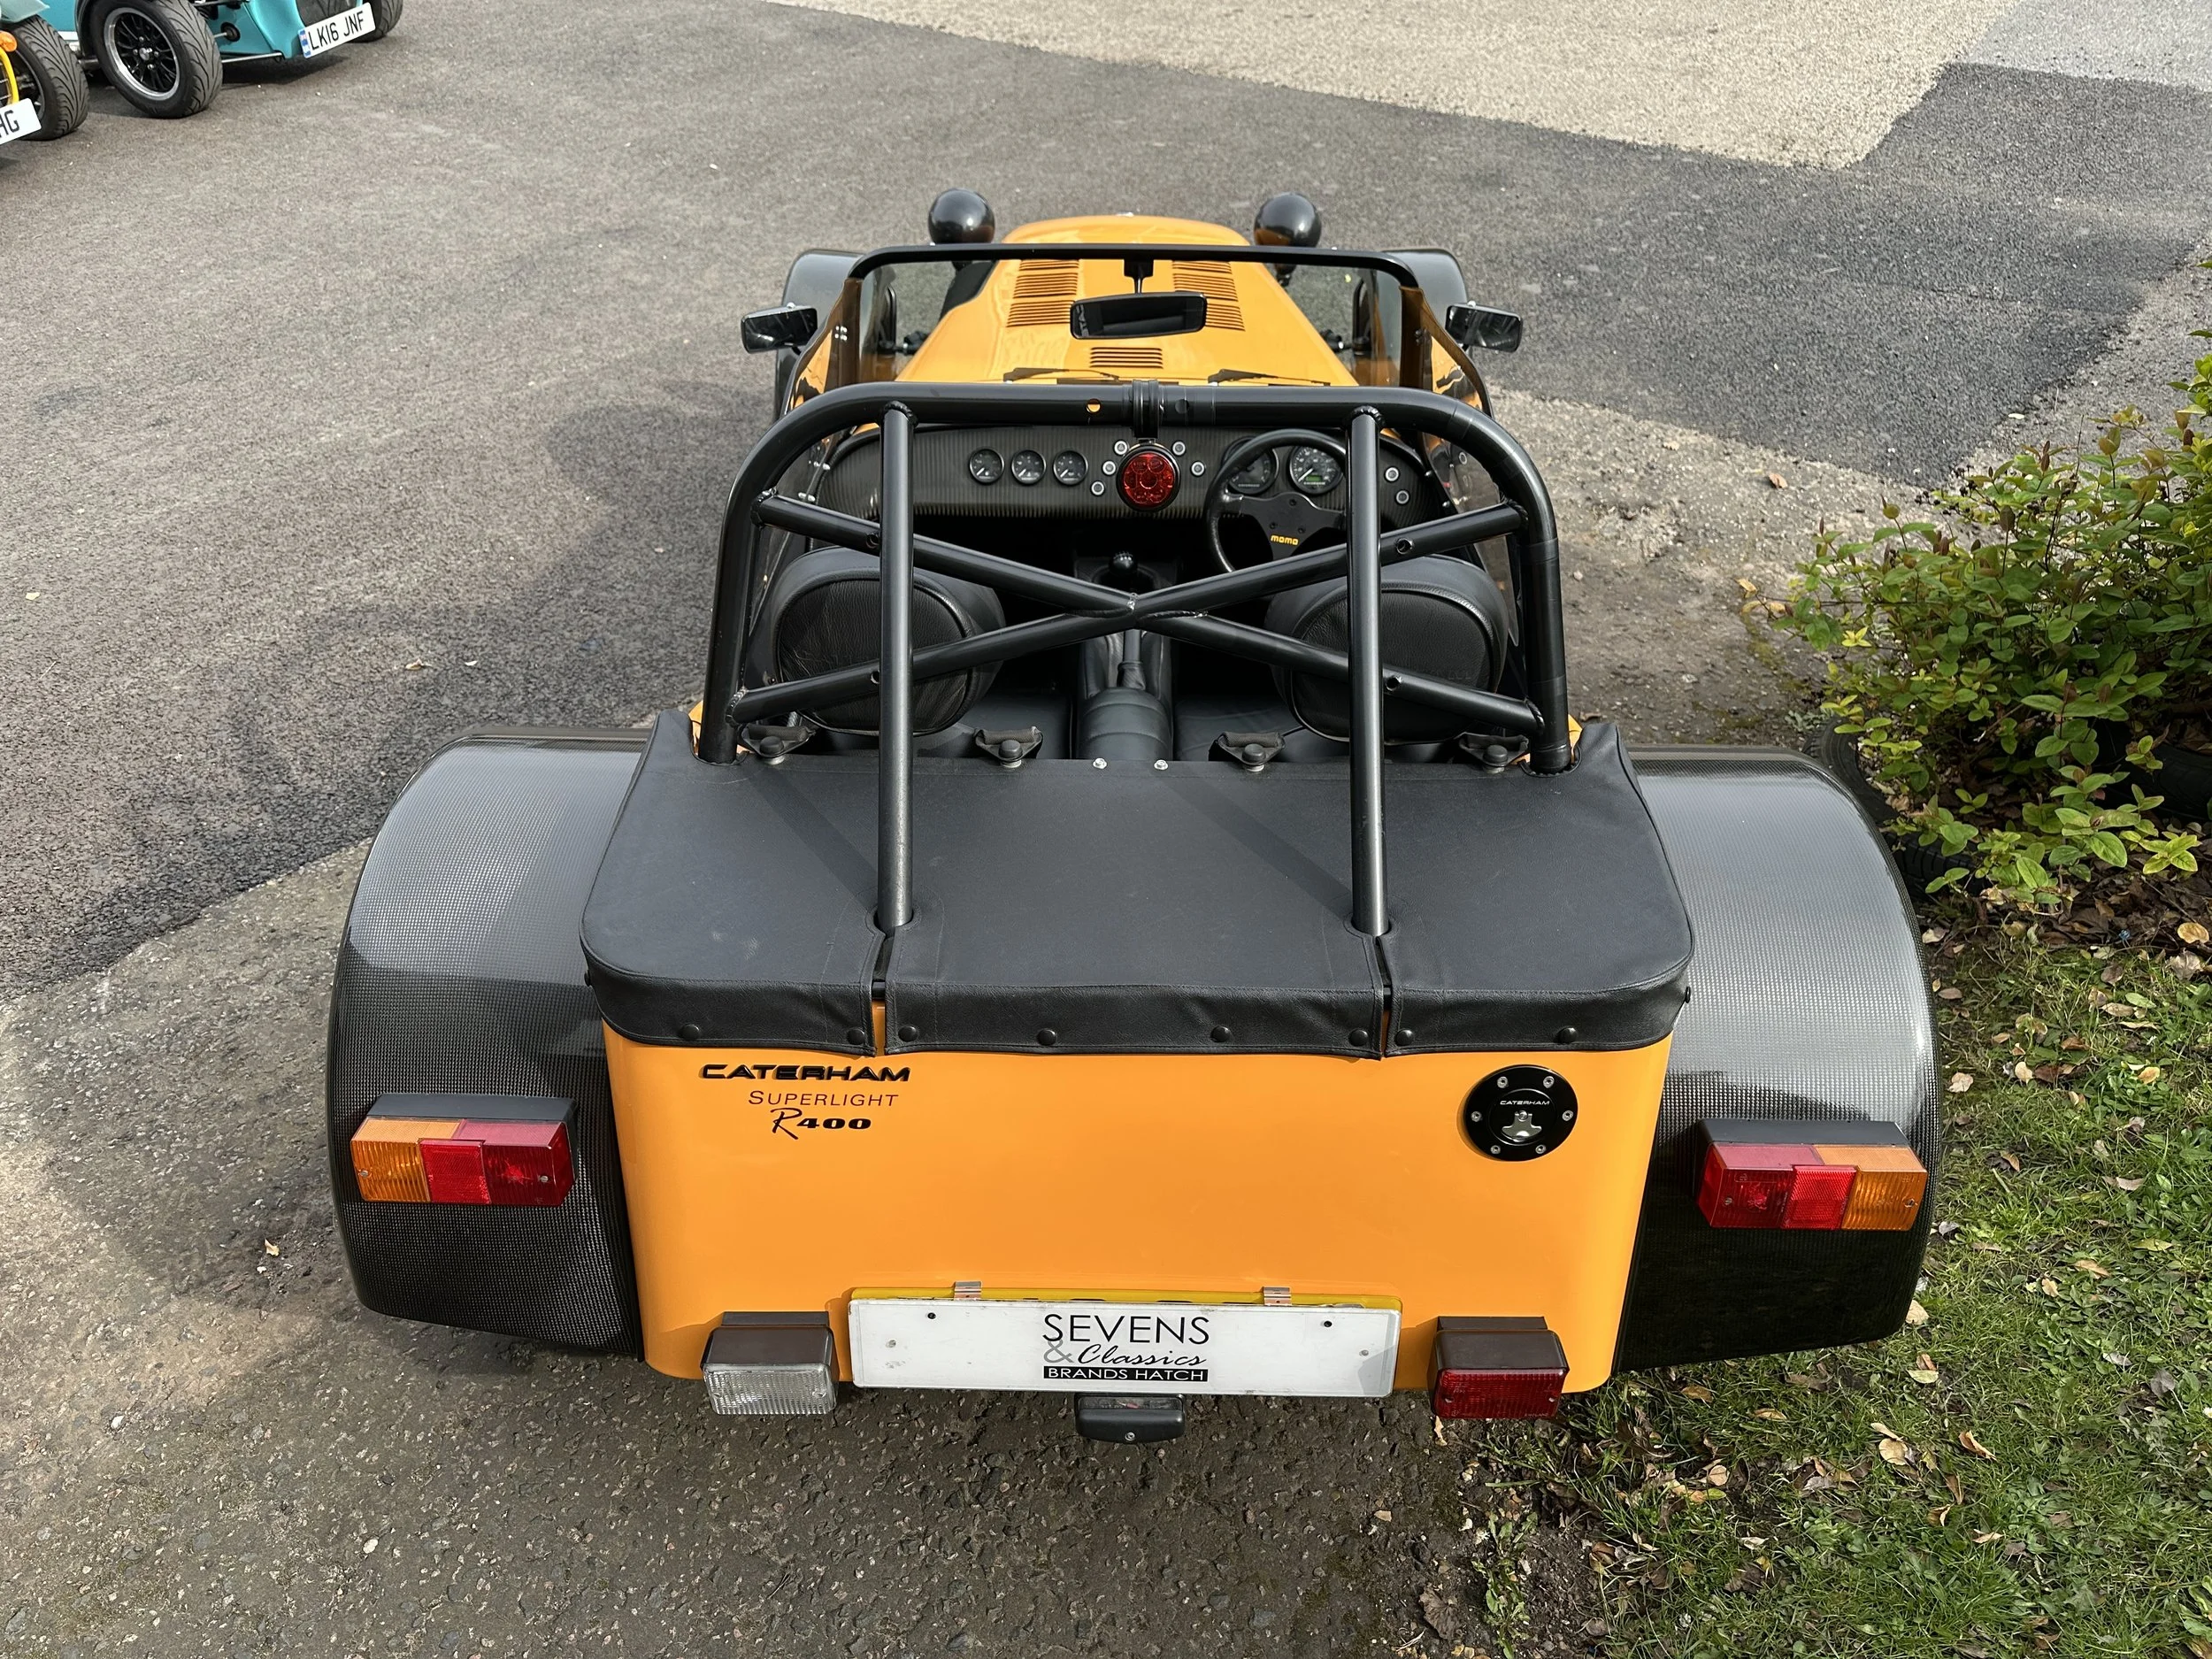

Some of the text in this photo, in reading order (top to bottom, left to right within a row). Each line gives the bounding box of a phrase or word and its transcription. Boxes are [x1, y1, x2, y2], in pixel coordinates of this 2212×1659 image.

[308, 11, 364, 50] LK16 JNF
[702, 1064, 910, 1082] CATERHAM
[748, 1090, 899, 1107] SUPERLIGHT
[770, 1107, 872, 1141] R400
[1042, 1313, 1210, 1344] SEVENS
[1043, 1337, 1207, 1366] & Classics
[1048, 1367, 1204, 1381] BRANDS HATCH
